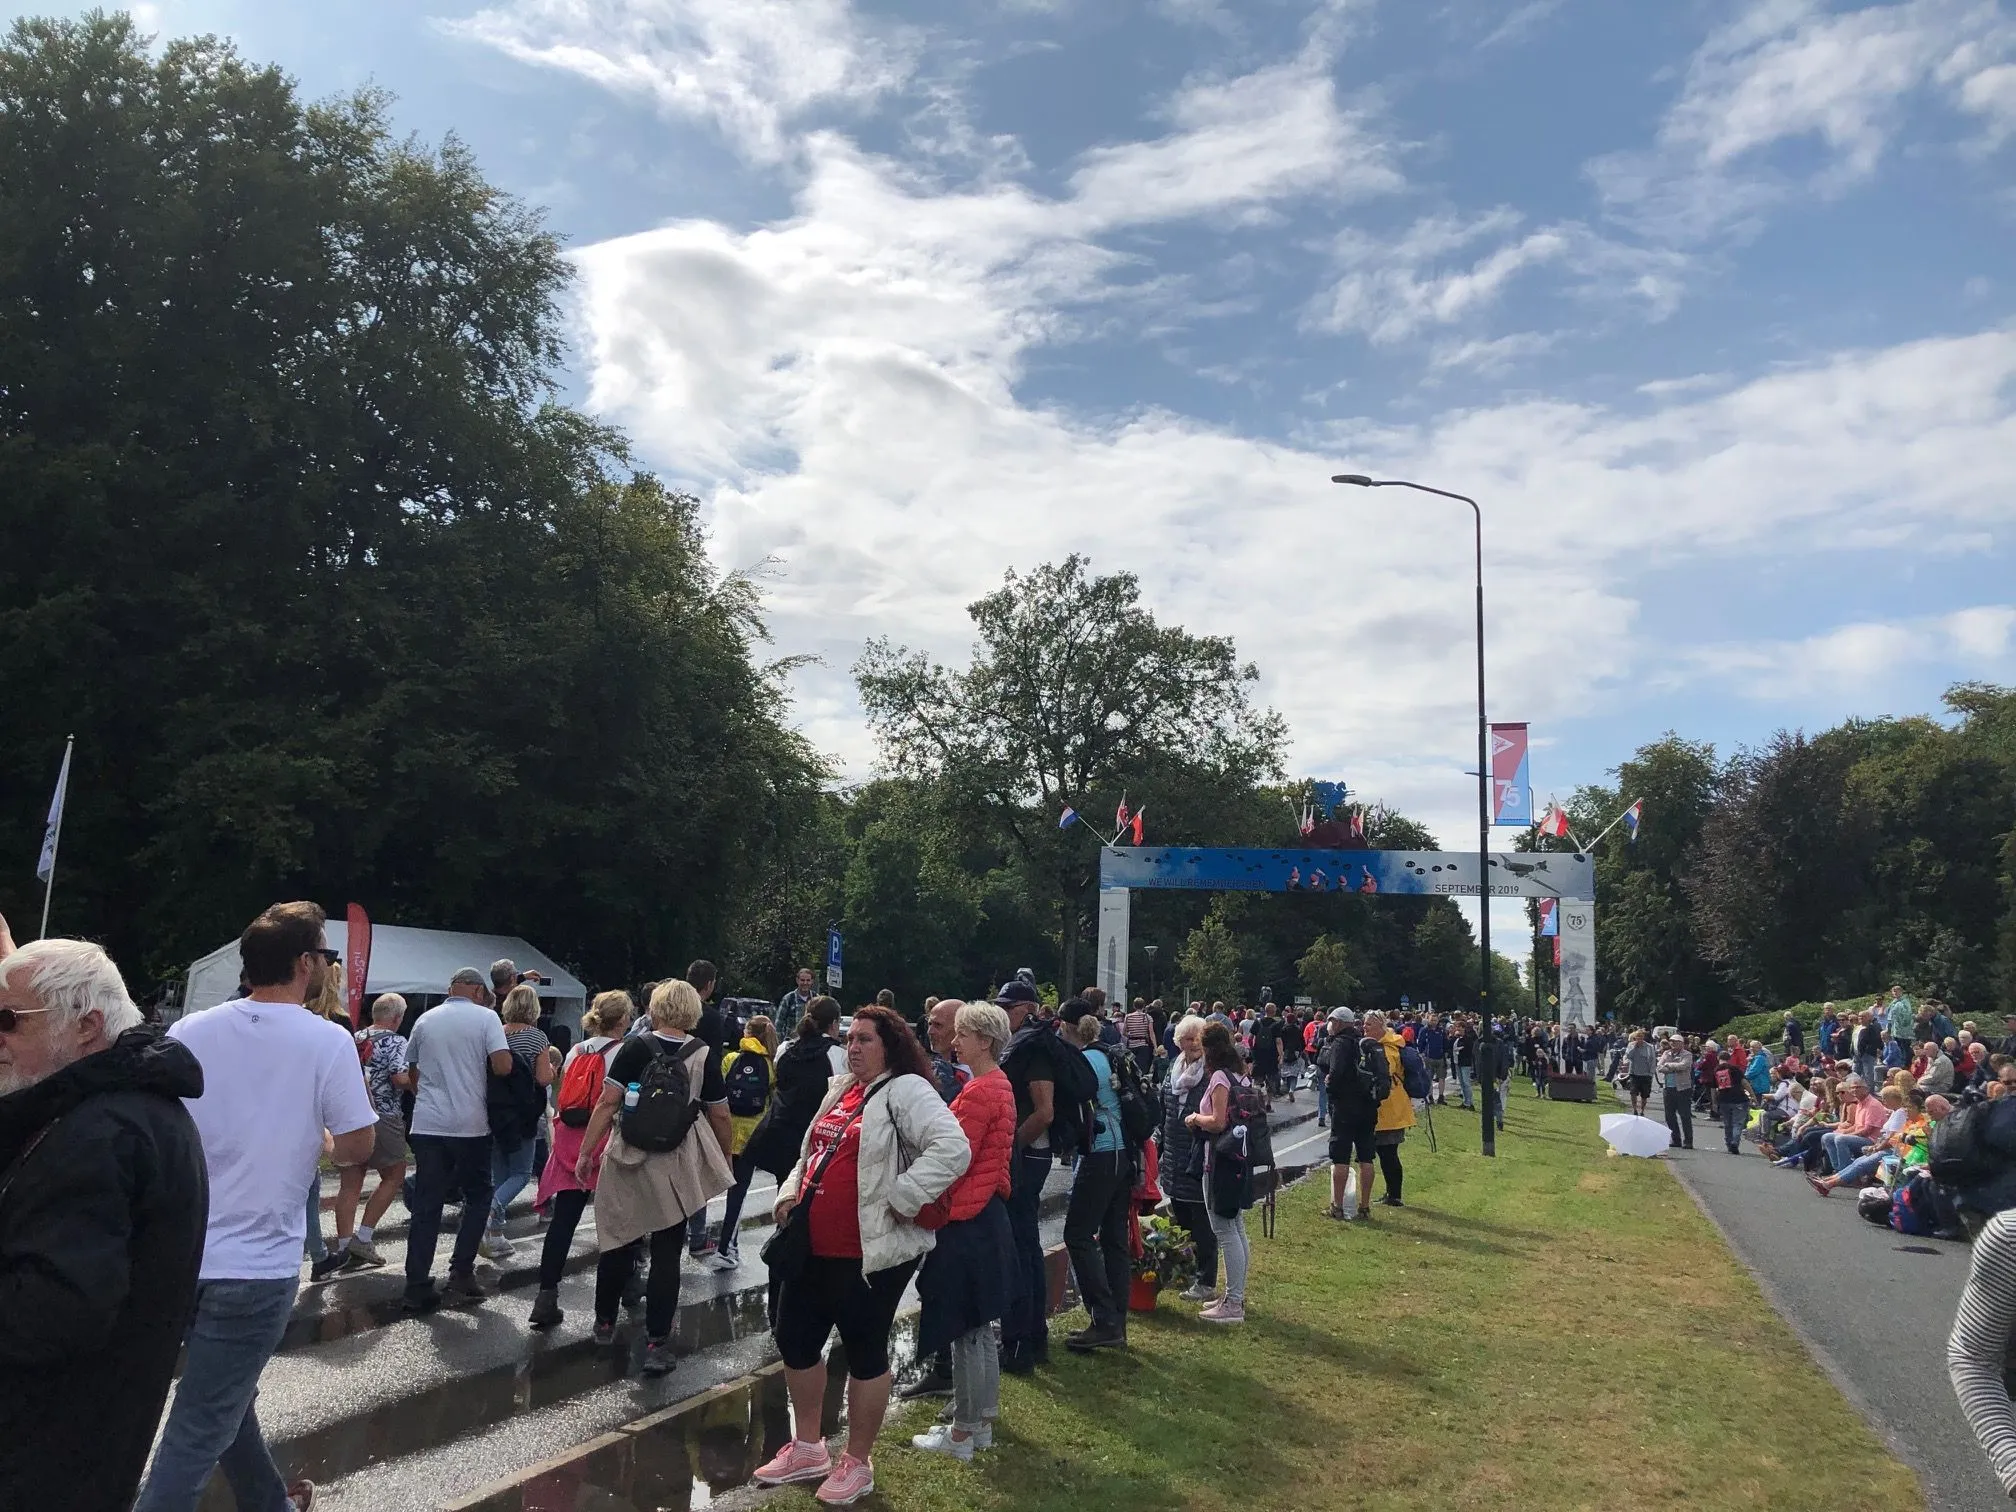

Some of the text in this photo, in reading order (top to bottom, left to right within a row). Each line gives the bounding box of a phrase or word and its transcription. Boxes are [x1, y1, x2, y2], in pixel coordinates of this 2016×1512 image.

[1495, 779, 1521, 808] 75
[1148, 878, 1162, 887] WE
[1163, 878, 1185, 887] WILL
[1435, 884, 1519, 895] SEPTEMBR 2019
[1570, 915, 1582, 926] 75
[832, 935, 839, 962] P
